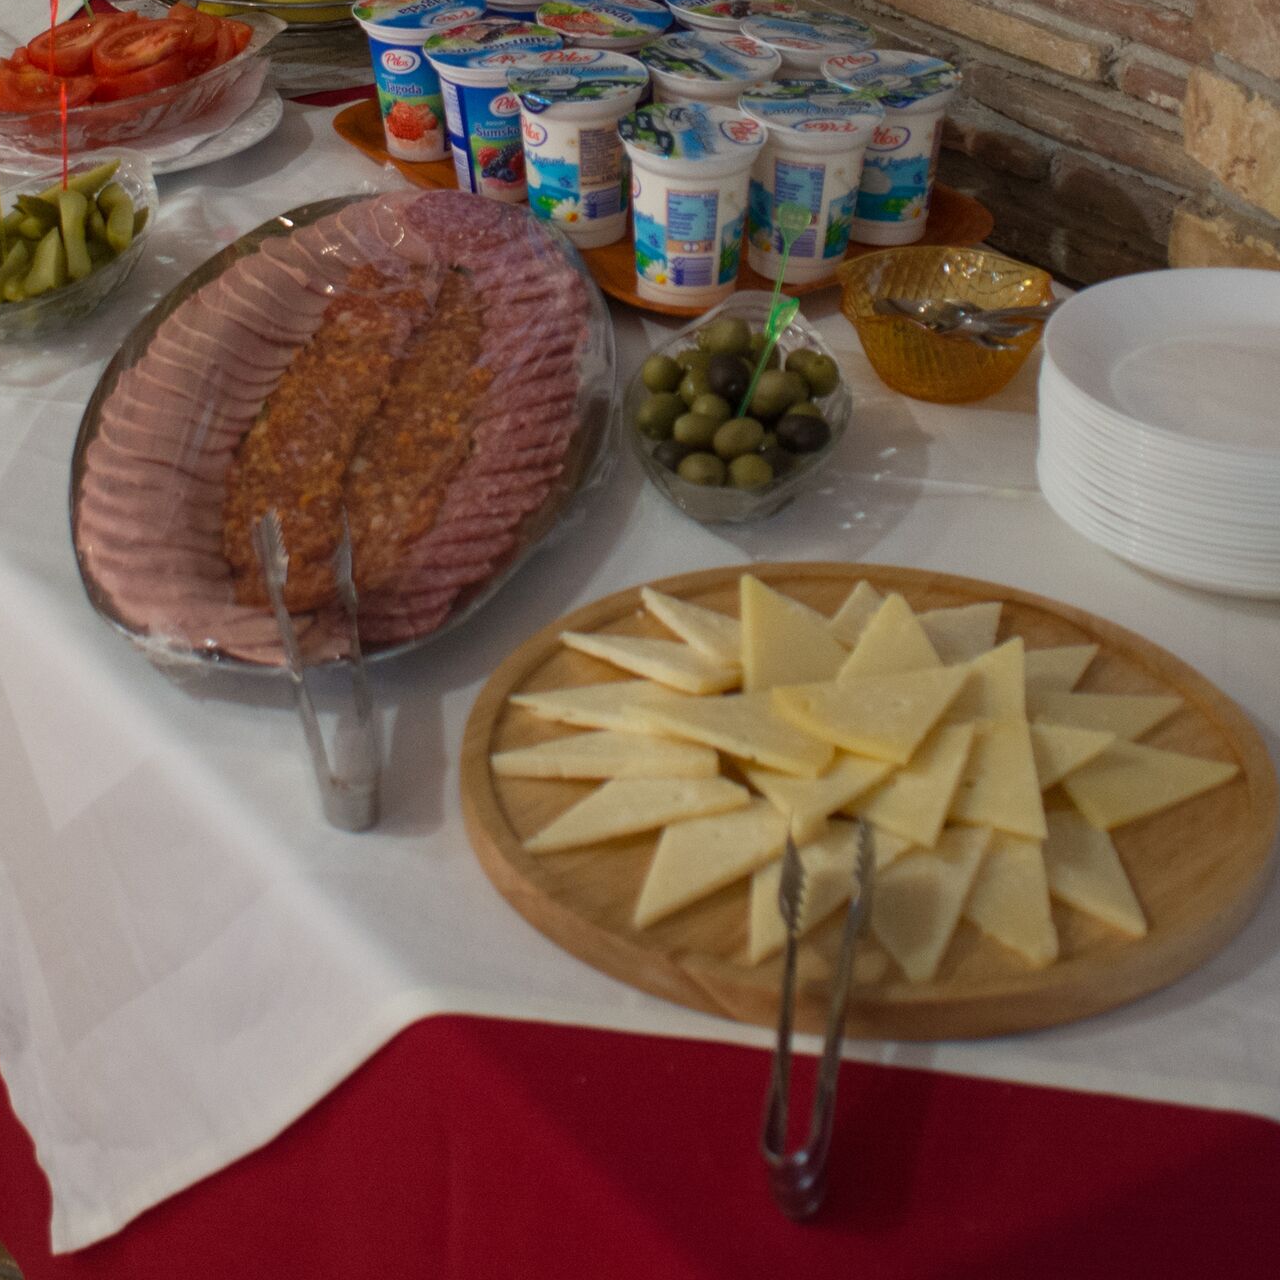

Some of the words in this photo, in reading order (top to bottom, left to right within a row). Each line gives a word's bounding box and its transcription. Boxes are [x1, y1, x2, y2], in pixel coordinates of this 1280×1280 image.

[384, 52, 411, 68] Pilos
[539, 51, 593, 64] Pilos
[385, 79, 423, 97] Jagoda
